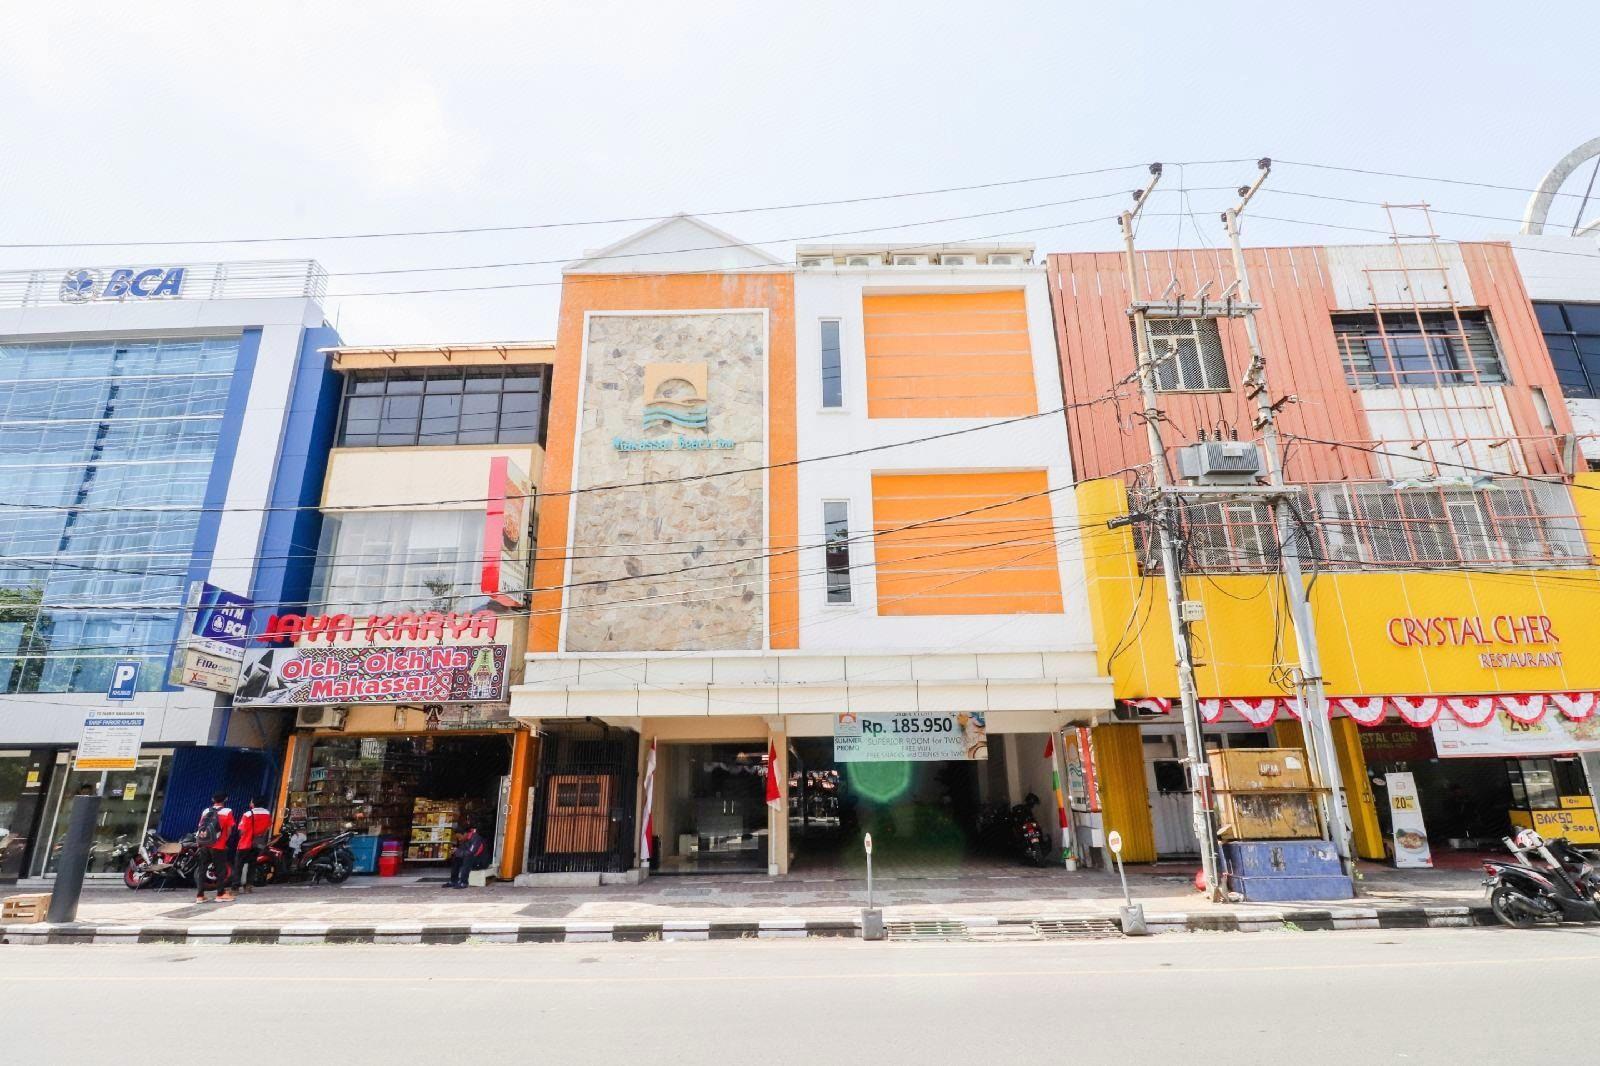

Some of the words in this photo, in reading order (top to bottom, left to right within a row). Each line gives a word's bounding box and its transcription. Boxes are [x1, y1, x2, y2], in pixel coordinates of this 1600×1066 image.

[102, 268, 185, 297] BCA
[221, 601, 246, 620] ATM
[223, 621, 247, 638] BCA
[365, 609, 498, 642] KARYA
[1386, 616, 1494, 647] CRYSTAL
[1492, 614, 1561, 646] CHER
[282, 656, 342, 681] Oleh
[364, 652, 427, 675] Oleh
[430, 648, 470, 670] Na
[1479, 651, 1563, 668] RESTAURANT
[309, 673, 437, 700] Makassar
[862, 719, 887, 738] Rp.
[891, 717, 953, 734] 185.950
[835, 736, 862, 744] SUMMER
[836, 744, 860, 752] PROMO
[867, 737, 904, 746] SUPERIOR
[905, 736, 930, 745] ROOM
[932, 736, 943, 745] for
[943, 735, 962, 744] TWO
[1535, 812, 1574, 825] BAKSO
